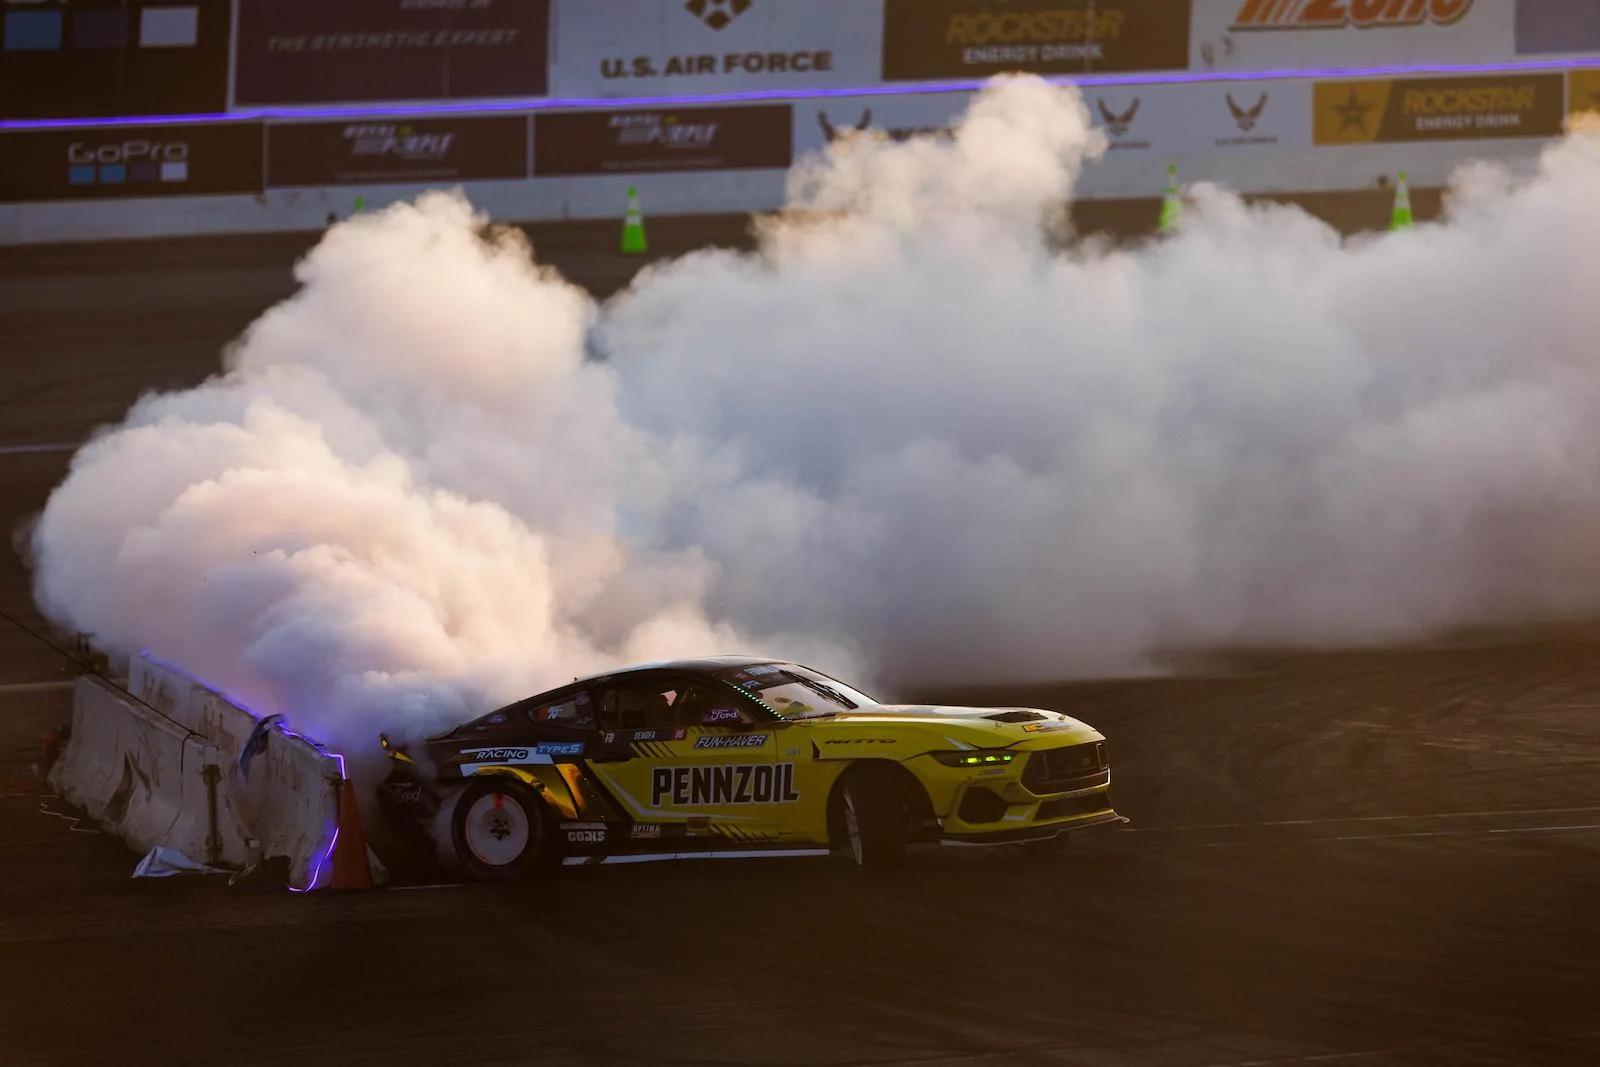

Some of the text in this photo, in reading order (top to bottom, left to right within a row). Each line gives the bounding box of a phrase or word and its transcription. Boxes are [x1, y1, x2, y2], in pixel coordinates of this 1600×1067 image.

[945, 9, 1127, 44] ROCKSTAR
[267, 28, 519, 52] THE SYNTHETIC EXPERT
[962, 42, 1103, 65] ENERGY DRINK
[601, 51, 833, 80] U.S. AIR FORCE
[1403, 86, 1536, 116] ROCKSTAR
[1415, 112, 1522, 131] ENERGY DRINK
[68, 141, 188, 163] GoPro
[710, 709, 739, 721] Ford
[633, 731, 656, 741] DENOFA
[696, 735, 766, 748] FUN-HAVER
[476, 749, 528, 760] RACING
[651, 763, 799, 806] PENNZOIL
[632, 823, 660, 833] OPTIMA
